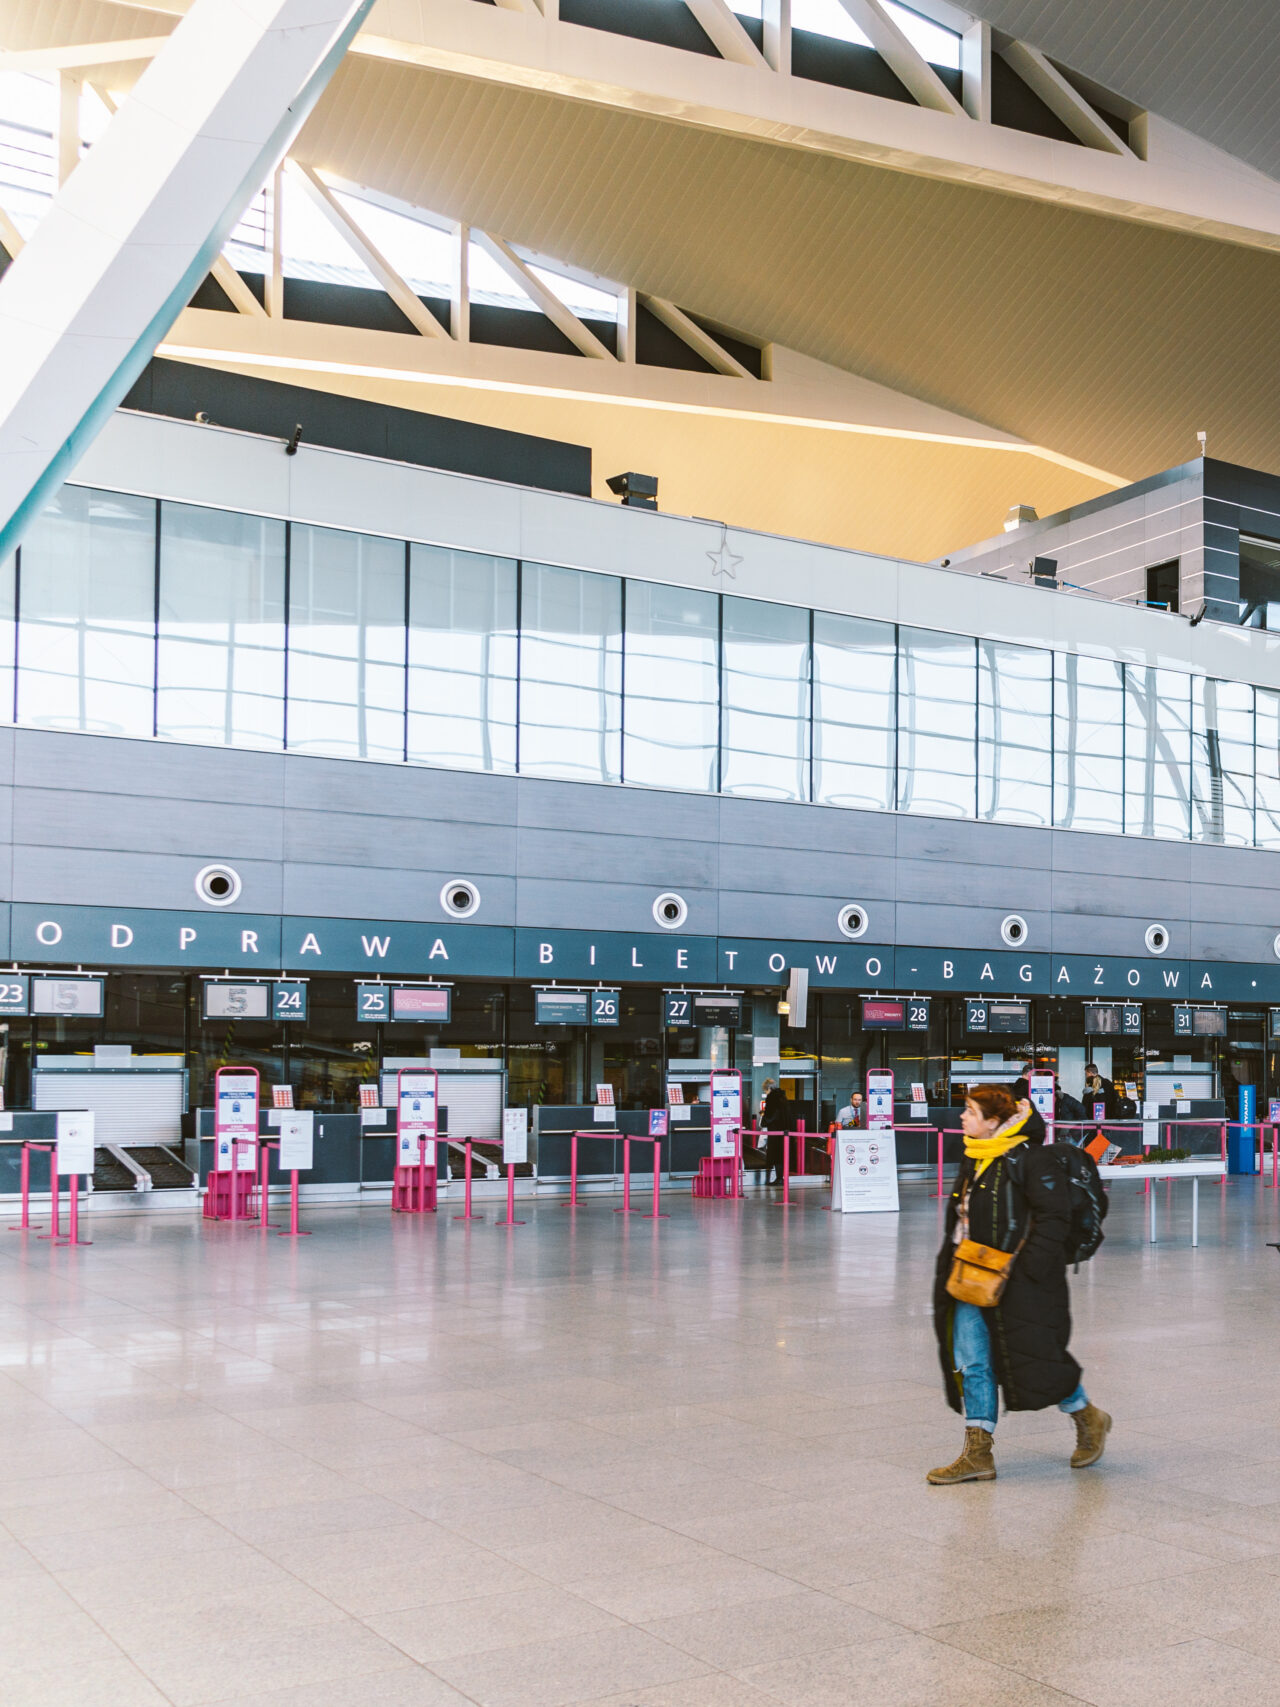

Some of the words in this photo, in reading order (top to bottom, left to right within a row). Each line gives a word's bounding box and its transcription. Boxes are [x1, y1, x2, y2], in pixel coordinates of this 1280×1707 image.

[36, 921, 449, 960] ODPRAWA
[540, 943, 1212, 988] BILETOWO-BAGAŻOWA
[0, 984, 23, 1003] 23
[277, 991, 301, 1008] 24
[362, 994, 384, 1010] 25
[595, 1000, 615, 1015] 26
[669, 1001, 688, 1016] 27
[910, 1007, 926, 1021] 28
[970, 1009, 985, 1023] 29
[1125, 1013, 1139, 1026] 30
[1177, 1014, 1189, 1027] 31
